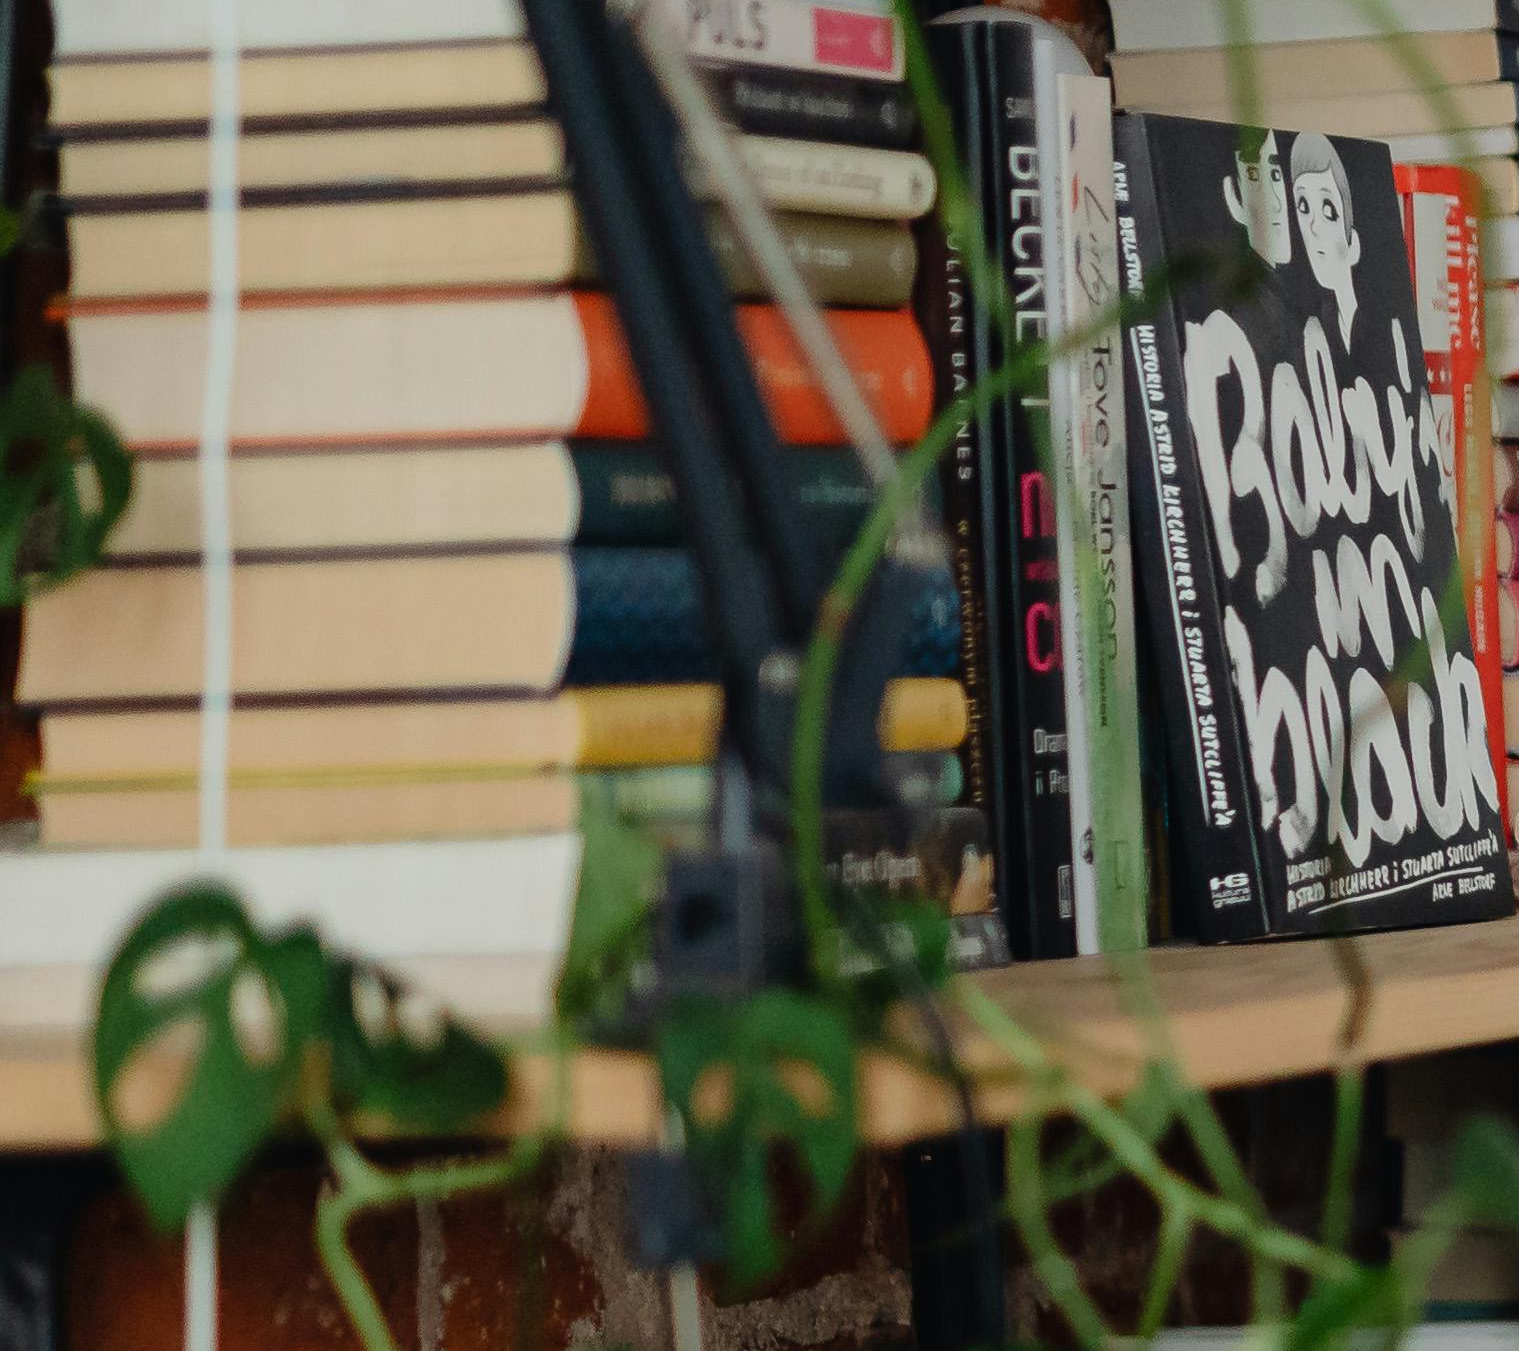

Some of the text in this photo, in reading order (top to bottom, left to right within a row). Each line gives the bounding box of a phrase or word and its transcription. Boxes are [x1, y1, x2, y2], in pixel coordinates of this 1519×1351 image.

[1136, 324, 1165, 403] HISTORIA
[950, 352, 973, 482] BANES
[1149, 408, 1177, 475] ASTRID
[1091, 336, 1119, 661] Tove Jansson
[1161, 484, 1197, 603] KIRCHHERR
[1313, 533, 1423, 671] in
[1184, 624, 1214, 708] STUARTA
[1225, 586, 1500, 868] black
[1286, 856, 1332, 886] HISTORIA
[1287, 880, 1326, 913] ASTRID
[1401, 849, 1445, 880] STUARTA
